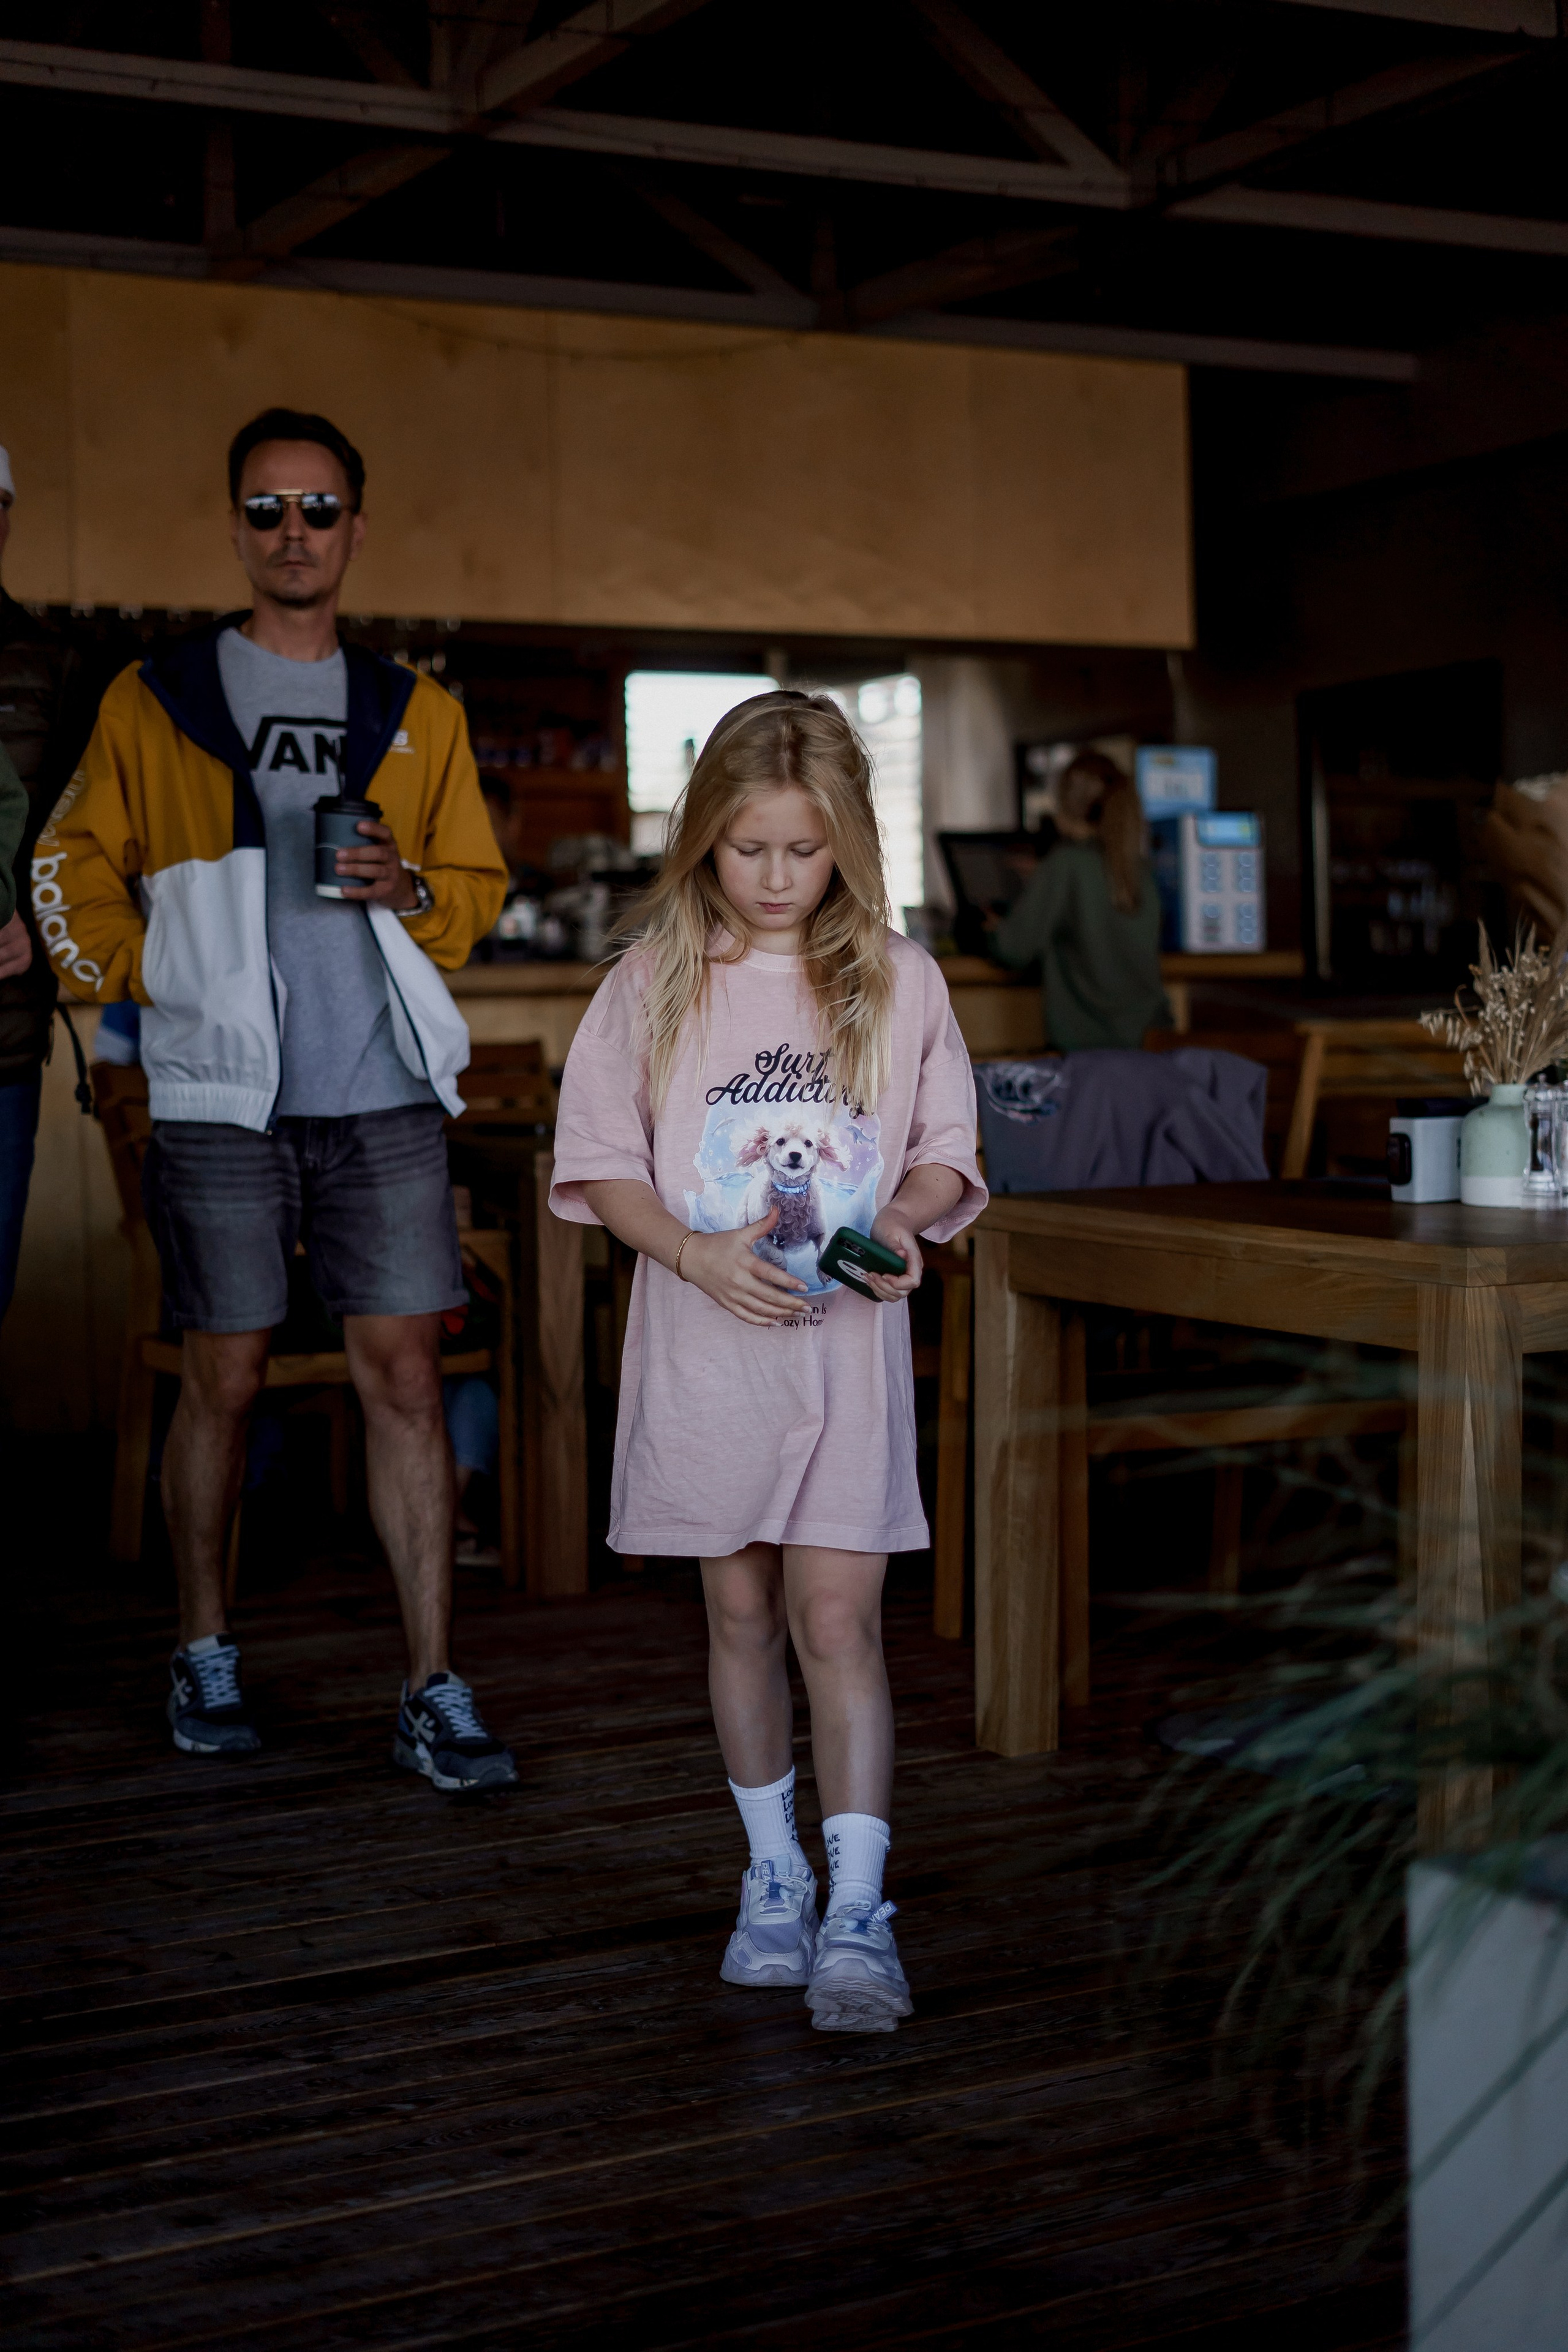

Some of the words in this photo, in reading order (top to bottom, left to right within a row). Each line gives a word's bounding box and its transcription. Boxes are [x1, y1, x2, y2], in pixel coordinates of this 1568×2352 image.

[246, 716, 347, 774] VAN
[31, 852, 105, 992] balanc
[821, 1303, 827, 1314] Is
[775, 1316, 799, 1330] ozy
[761, 1863, 771, 1881] PEA
